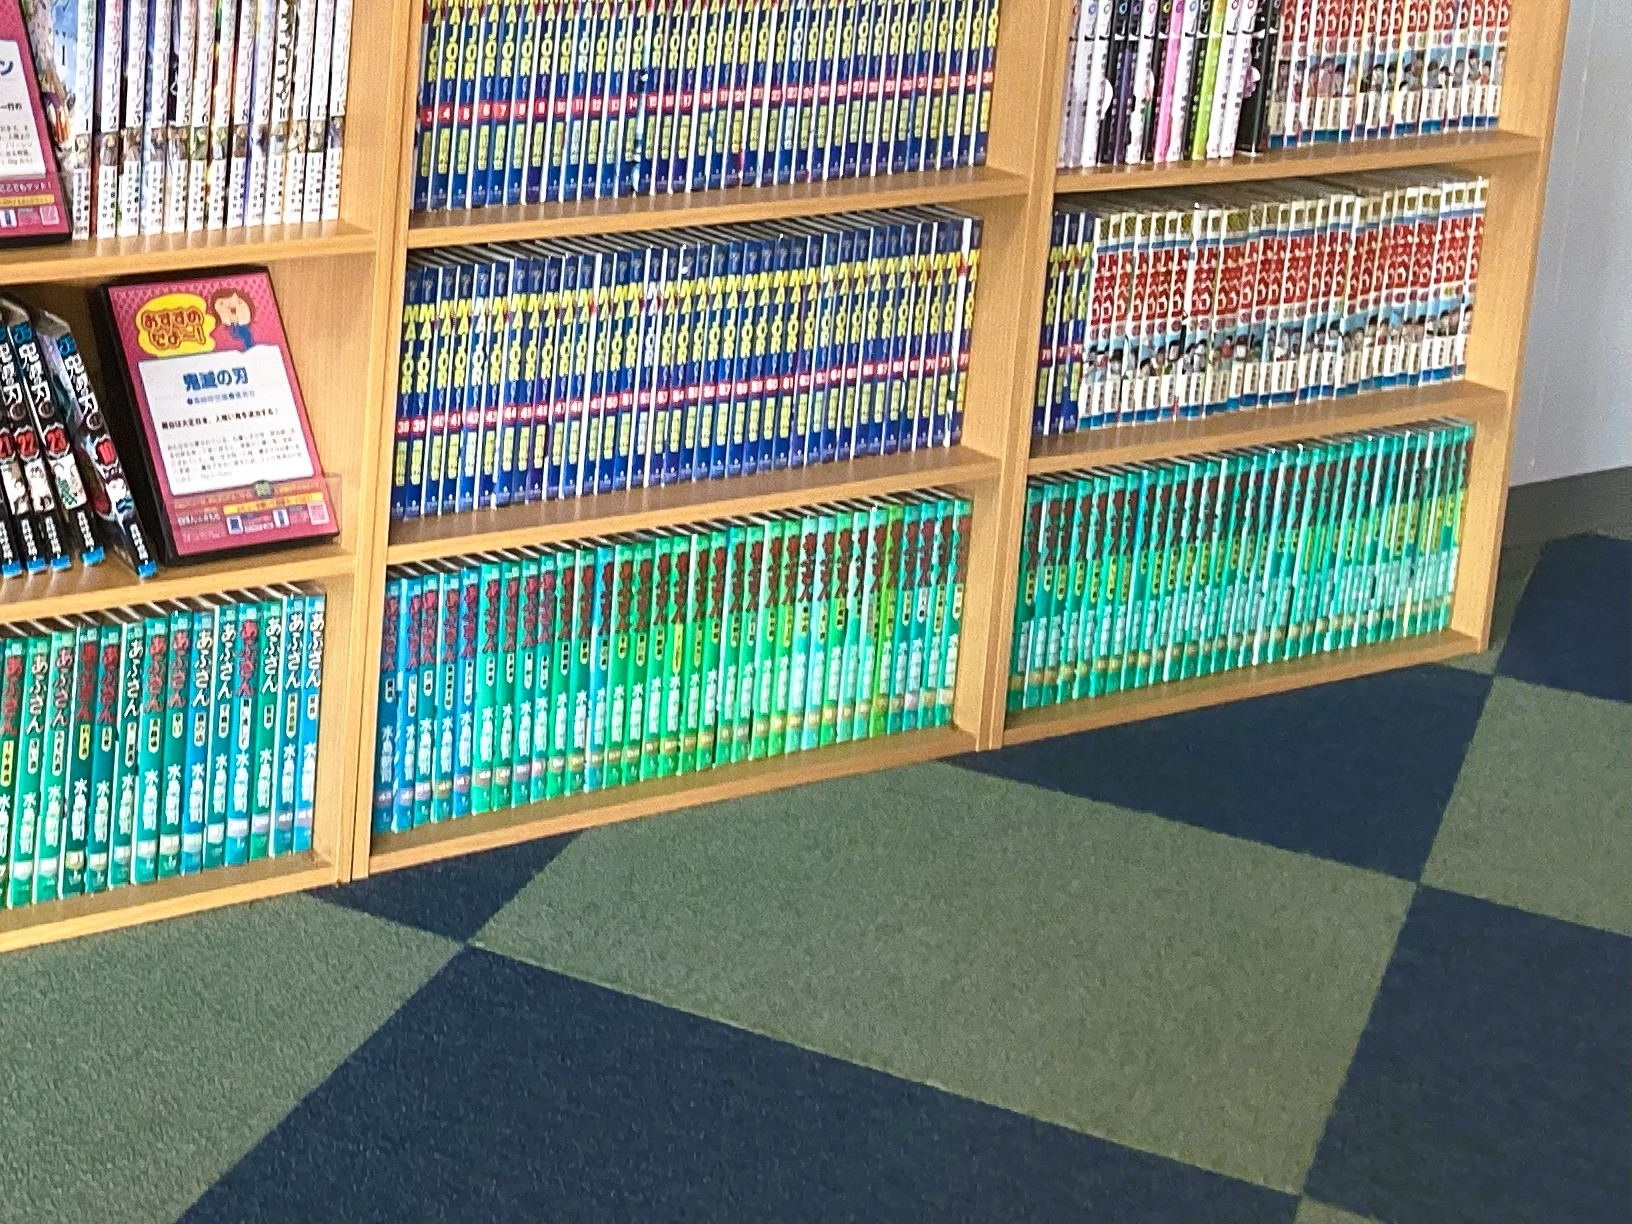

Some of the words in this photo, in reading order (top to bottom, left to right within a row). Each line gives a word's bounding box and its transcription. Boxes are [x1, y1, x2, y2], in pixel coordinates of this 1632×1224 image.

[400, 305, 418, 394] MAJOR
[471, 298, 486, 386] MAJOR
[182, 366, 248, 392] 鬼滅の刃
[18, 433, 35, 454] 22
